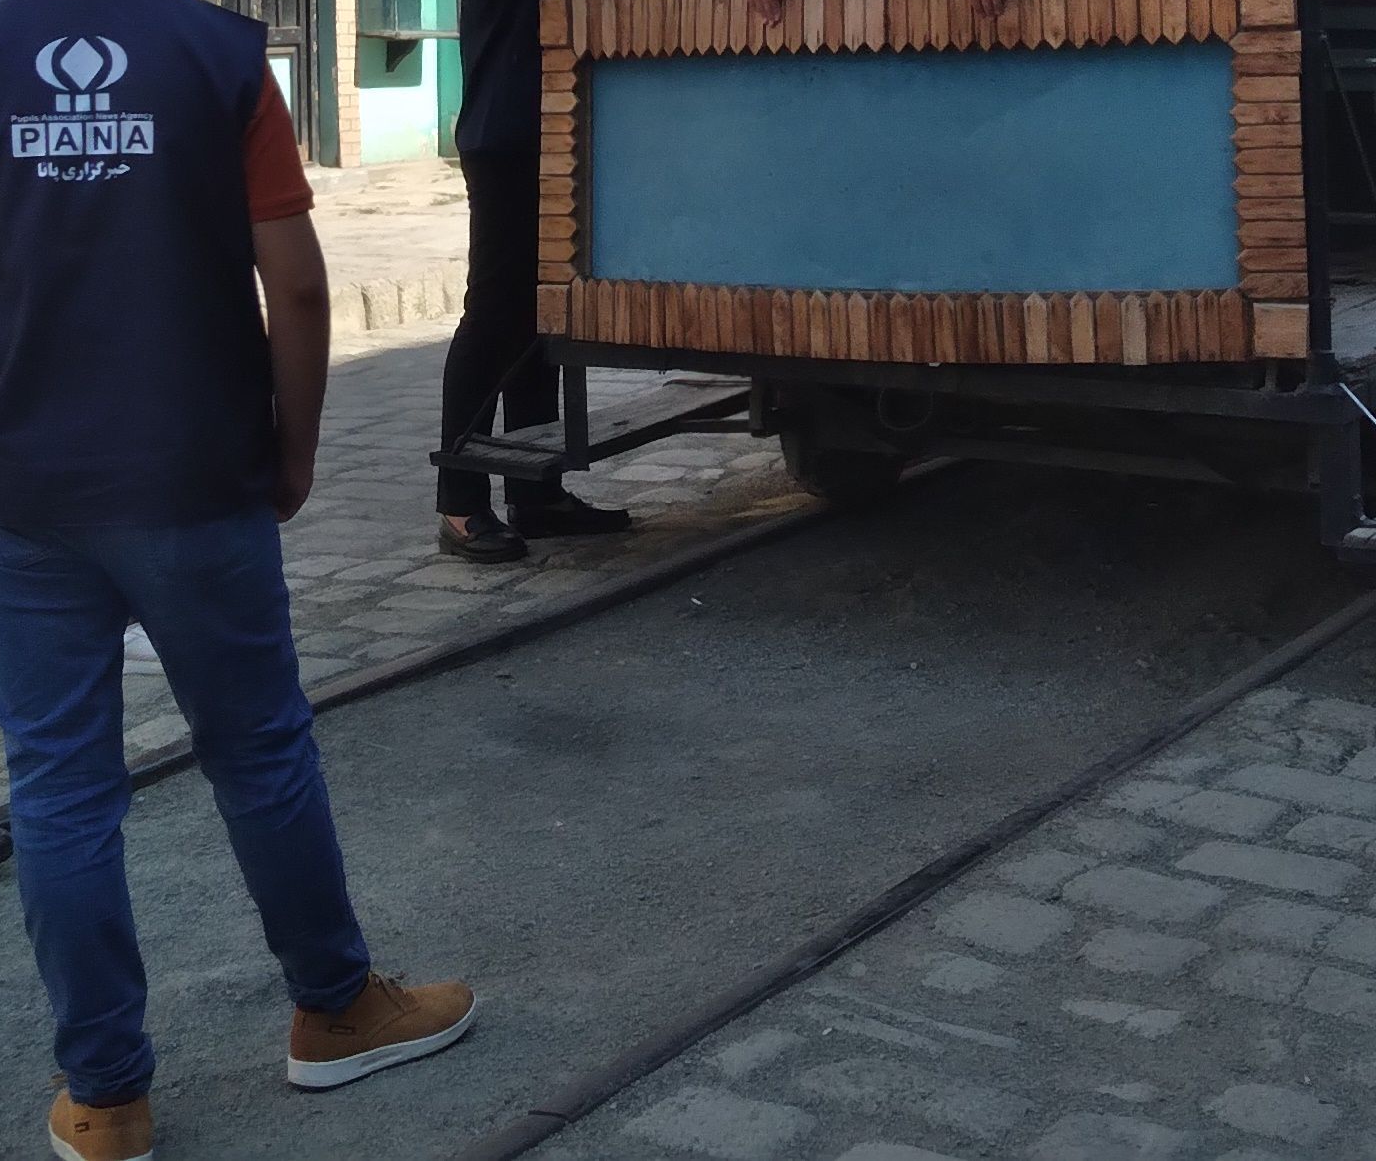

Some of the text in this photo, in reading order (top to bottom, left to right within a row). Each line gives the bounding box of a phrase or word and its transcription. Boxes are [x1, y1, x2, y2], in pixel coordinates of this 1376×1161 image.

[96, 112, 118, 120] News
[120, 111, 154, 121] Agency
[18, 123, 150, 154] PANA
[37, 161, 60, 182] پانا
